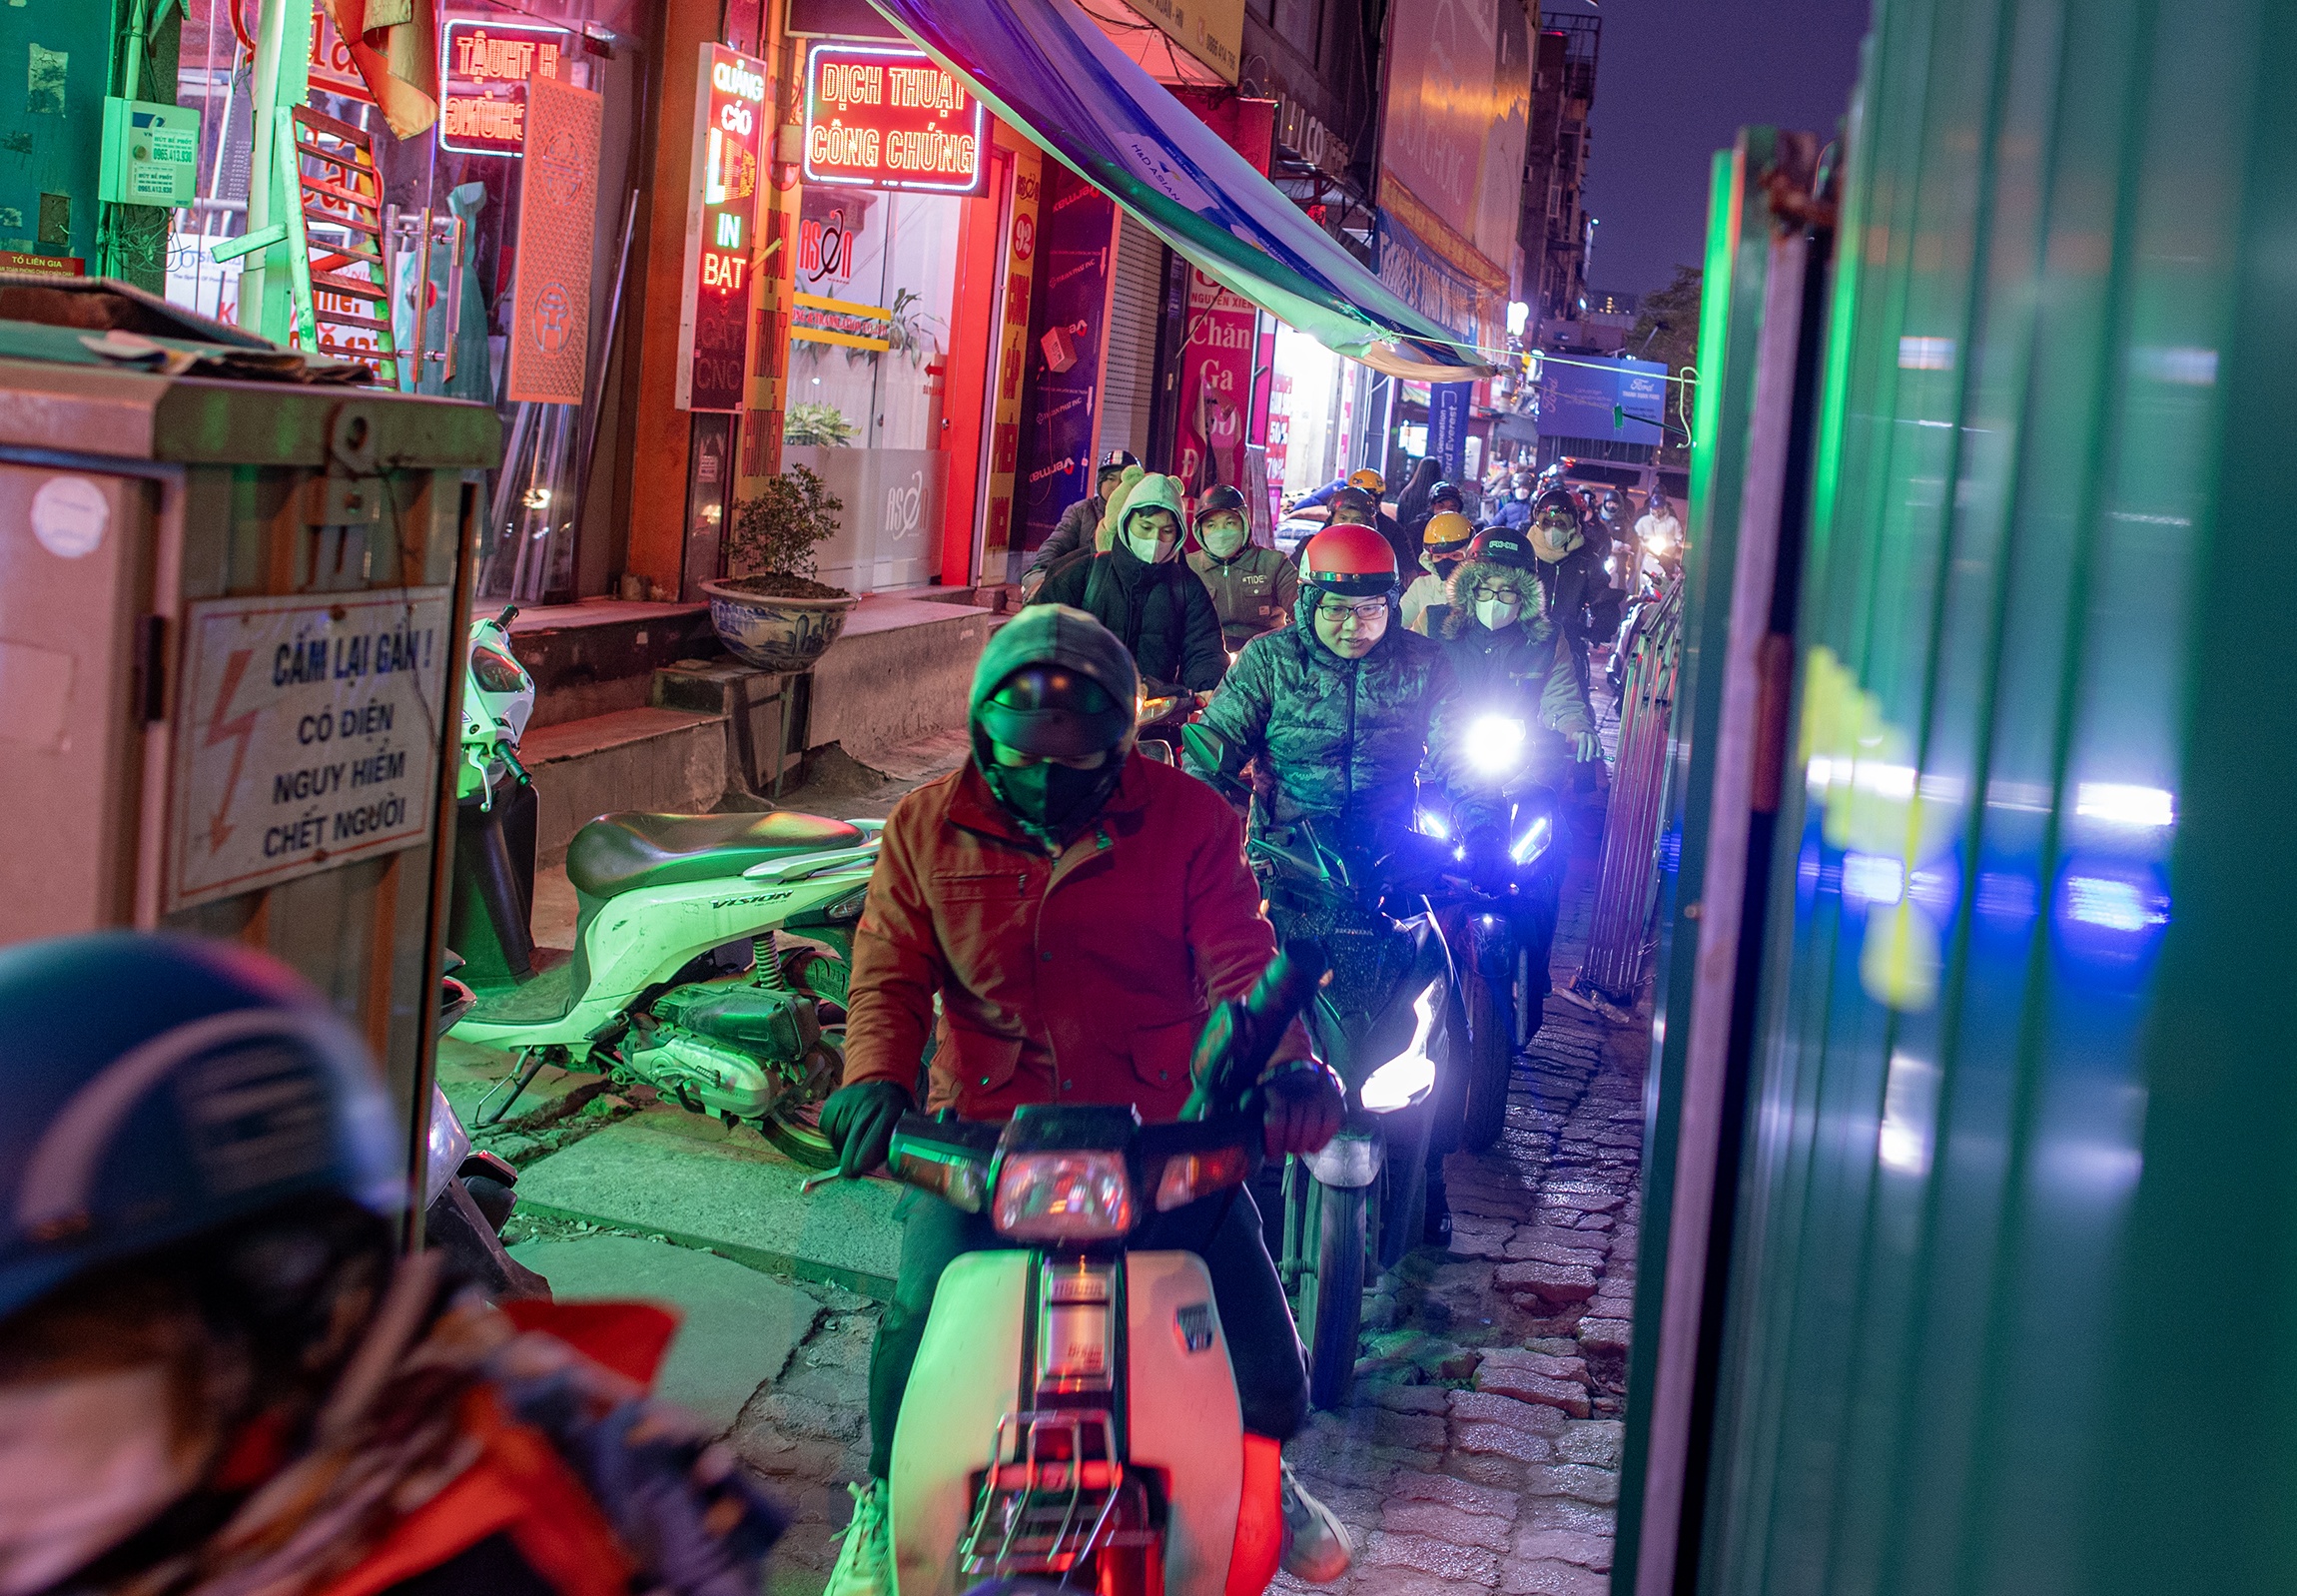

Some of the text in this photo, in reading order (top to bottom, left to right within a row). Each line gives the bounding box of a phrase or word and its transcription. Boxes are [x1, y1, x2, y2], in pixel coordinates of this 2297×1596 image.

[713, 58, 763, 102] QUẢNG
[821, 62, 884, 111] DỊCH
[721, 99, 752, 136] CÁO
[705, 127, 756, 205] LED
[810, 118, 975, 174] CÔNG CHỨNG
[1148, 167, 1180, 201] ASIAN
[716, 212, 741, 250] IN
[1015, 218, 1032, 254] 92
[12, 254, 24, 264] TỔ
[26, 257, 45, 267] LIÊN
[703, 254, 746, 295] BẠT
[1188, 314, 1250, 350] Chăn
[696, 358, 740, 391] CNC
[1200, 359, 1233, 392] Ga
[1445, 404, 1458, 450] Everest
[272, 623, 328, 687] CẤM
[334, 634, 371, 688] LẠI
[297, 703, 334, 745] CÓ
[272, 737, 405, 804] NGUY HIỂM
[264, 792, 407, 858] CHẾT NGƯỜI
[709, 889, 794, 910] VISION
